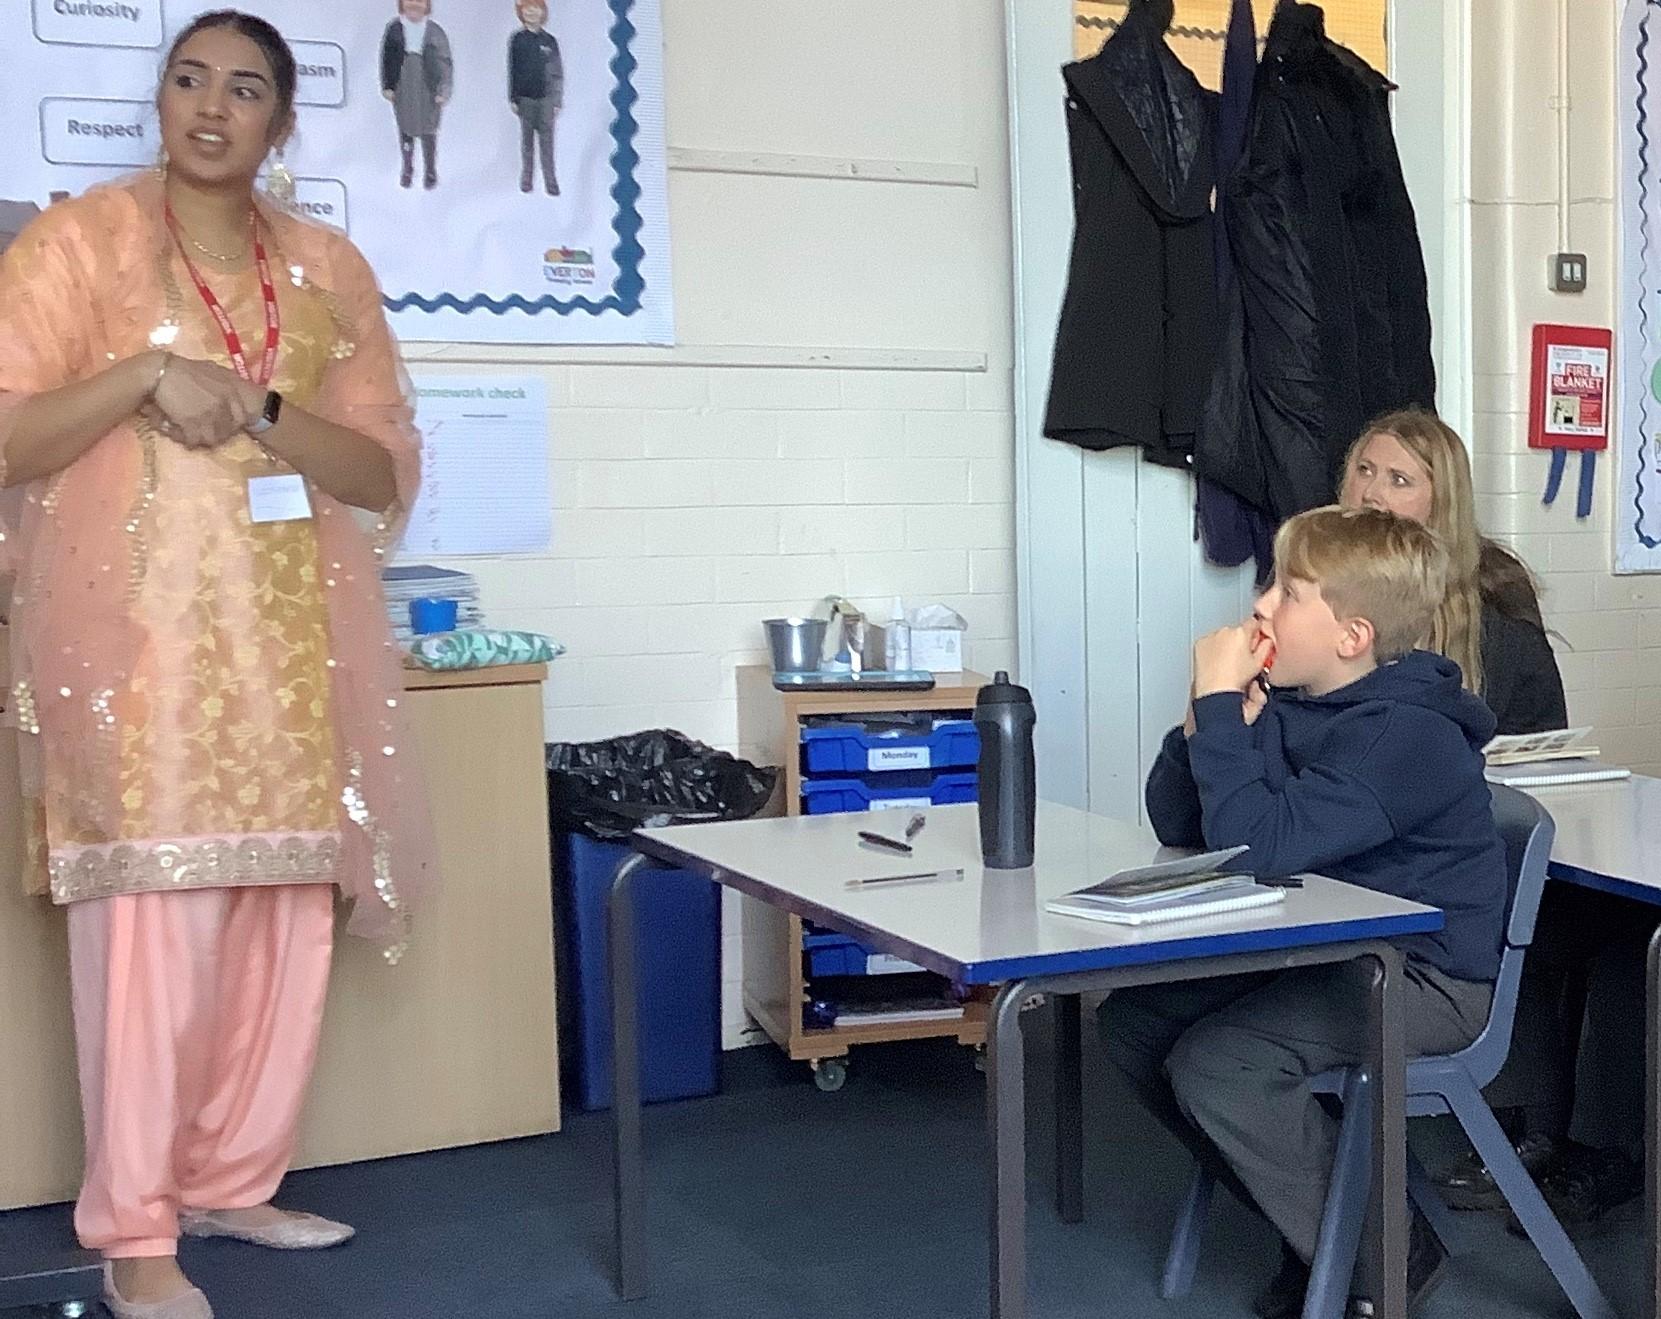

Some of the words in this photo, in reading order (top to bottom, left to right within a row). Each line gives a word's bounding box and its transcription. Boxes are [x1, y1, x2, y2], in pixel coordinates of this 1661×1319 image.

[53, 0, 140, 22] Curiosity
[67, 119, 144, 138] Respect
[1566, 364, 1590, 377] FIRE
[1553, 376, 1601, 389] BLANKET
[487, 386, 526, 399] check
